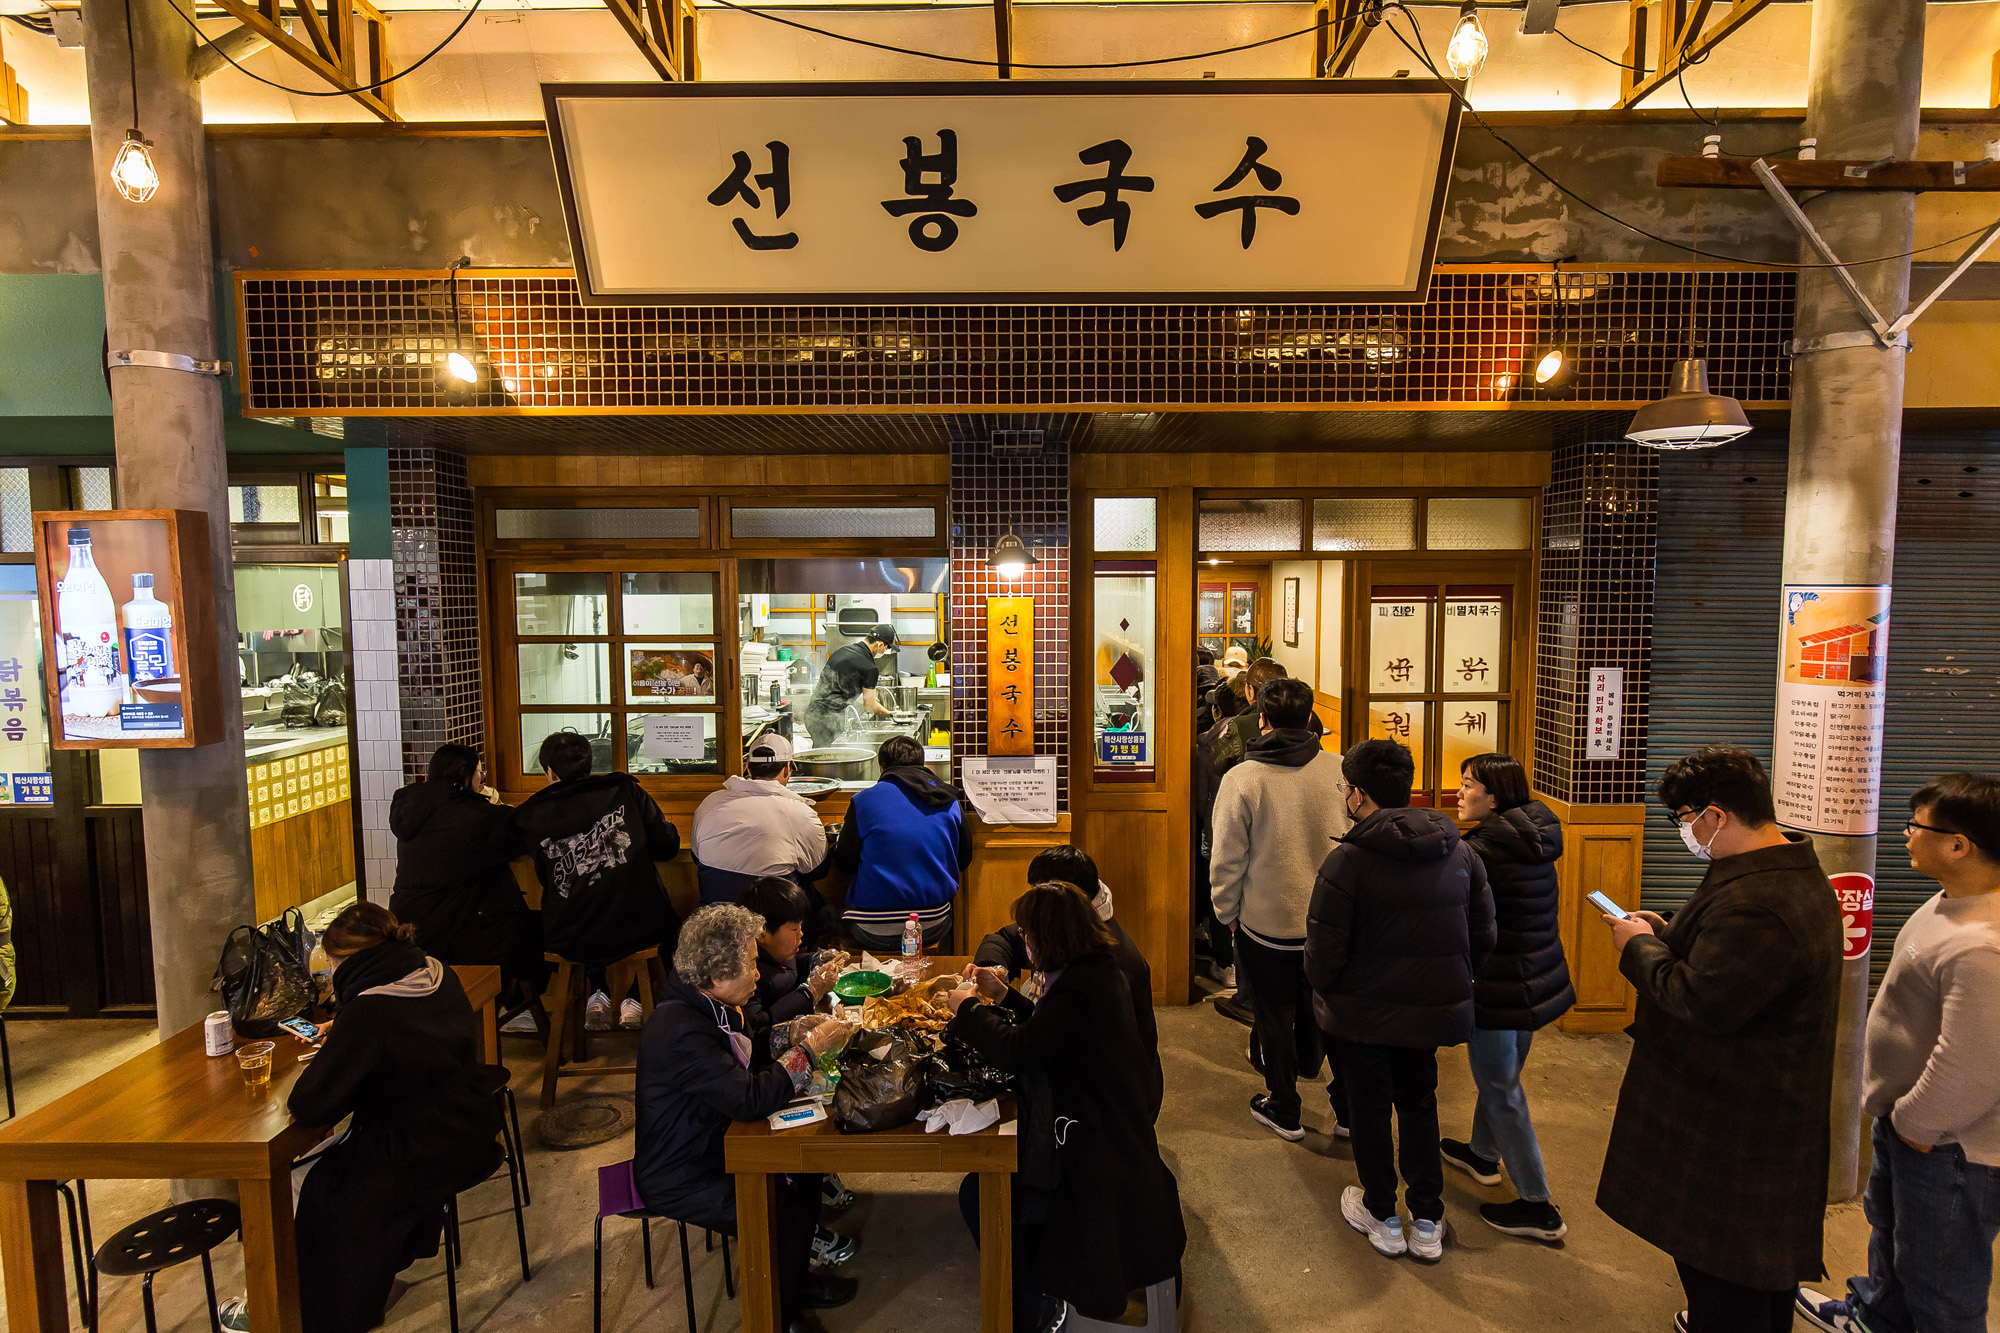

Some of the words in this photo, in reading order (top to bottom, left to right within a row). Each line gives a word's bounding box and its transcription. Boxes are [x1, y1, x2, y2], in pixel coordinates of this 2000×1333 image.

[651, 687, 676, 695] 국수가
[1596, 674, 1606, 692] 자리
[1595, 696, 1604, 714] 먼저
[1608, 692, 1614, 706] 메뉴
[1594, 717, 1603, 735] 확보
[1104, 735, 1145, 744] 예산사랑상품권
[1594, 739, 1602, 747] 후
[1834, 888, 1875, 912] 장실
